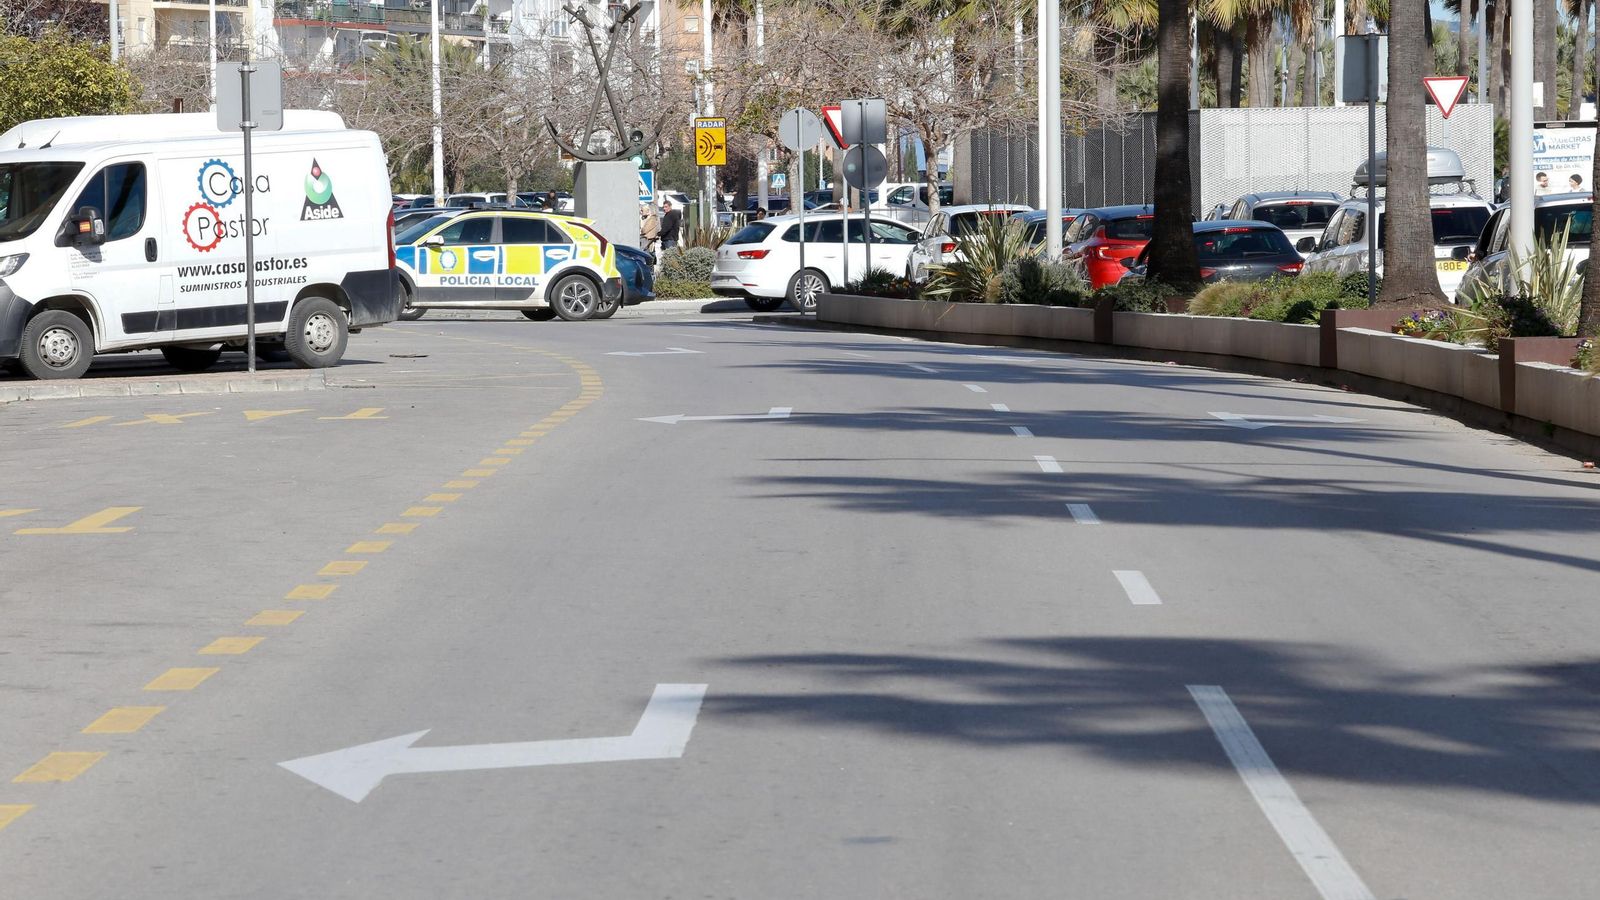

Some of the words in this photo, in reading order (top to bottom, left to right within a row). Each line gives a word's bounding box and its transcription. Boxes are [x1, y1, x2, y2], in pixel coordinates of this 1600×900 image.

[1549, 135, 1592, 144] GECIRAS
[208, 172, 271, 196] Caa
[304, 204, 340, 221] Aside
[177, 257, 308, 278] www.casaastor.es
[180, 280, 242, 293] SUMINISTROS
[244, 275, 308, 288] IDUSTRIALES
[440, 276, 491, 286] POLICIA
[497, 276, 540, 286] LOCAL
